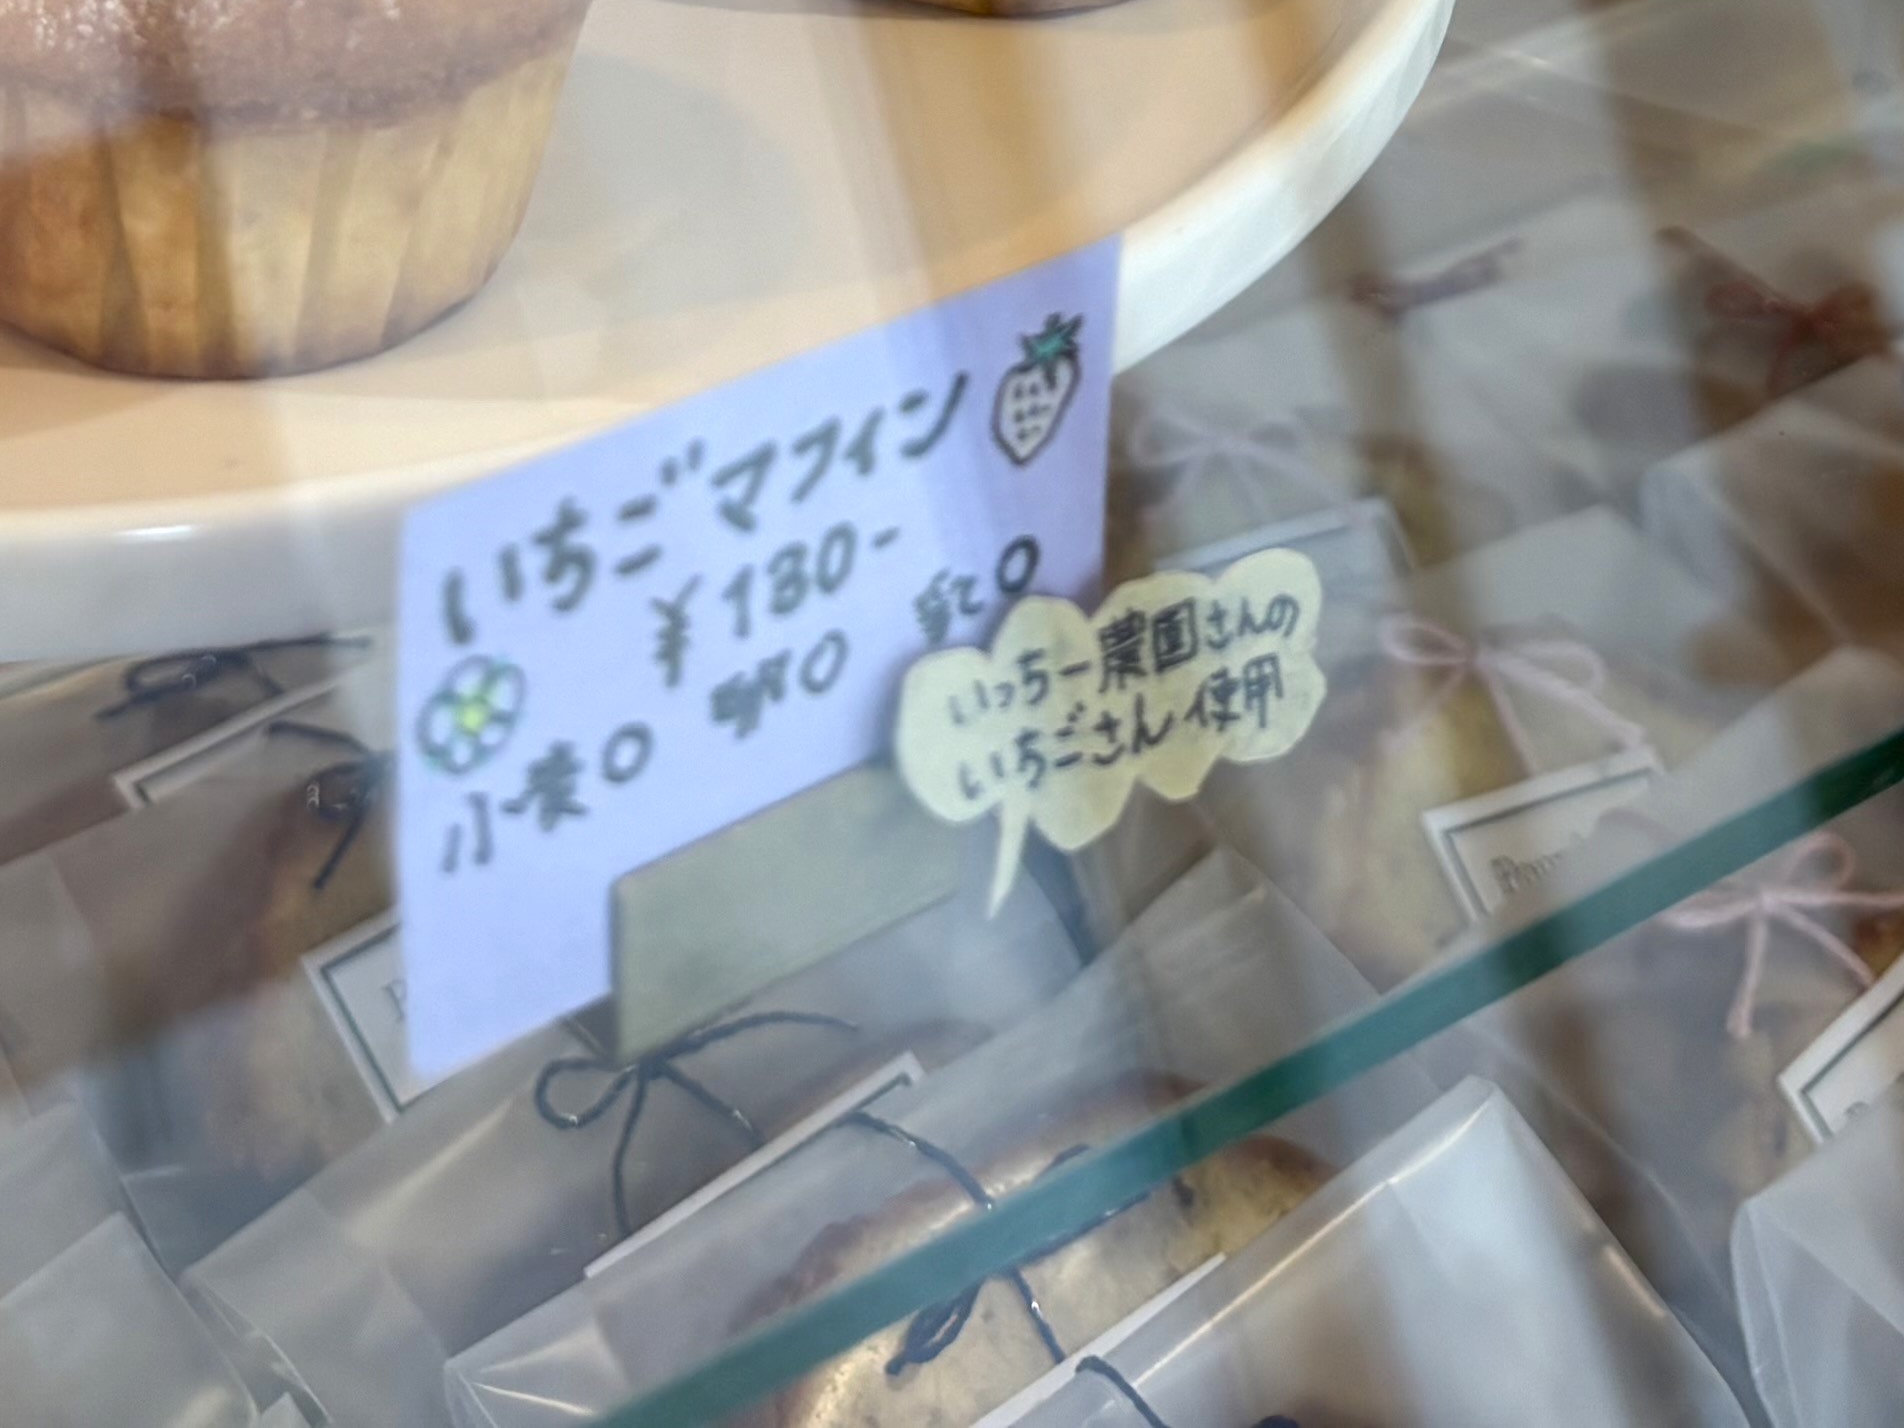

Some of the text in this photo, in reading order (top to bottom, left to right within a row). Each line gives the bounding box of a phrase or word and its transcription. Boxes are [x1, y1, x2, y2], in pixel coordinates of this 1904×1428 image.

[440, 371, 969, 644] いちごマフィン
[949, 593, 1299, 726] いっちー農園さんの
